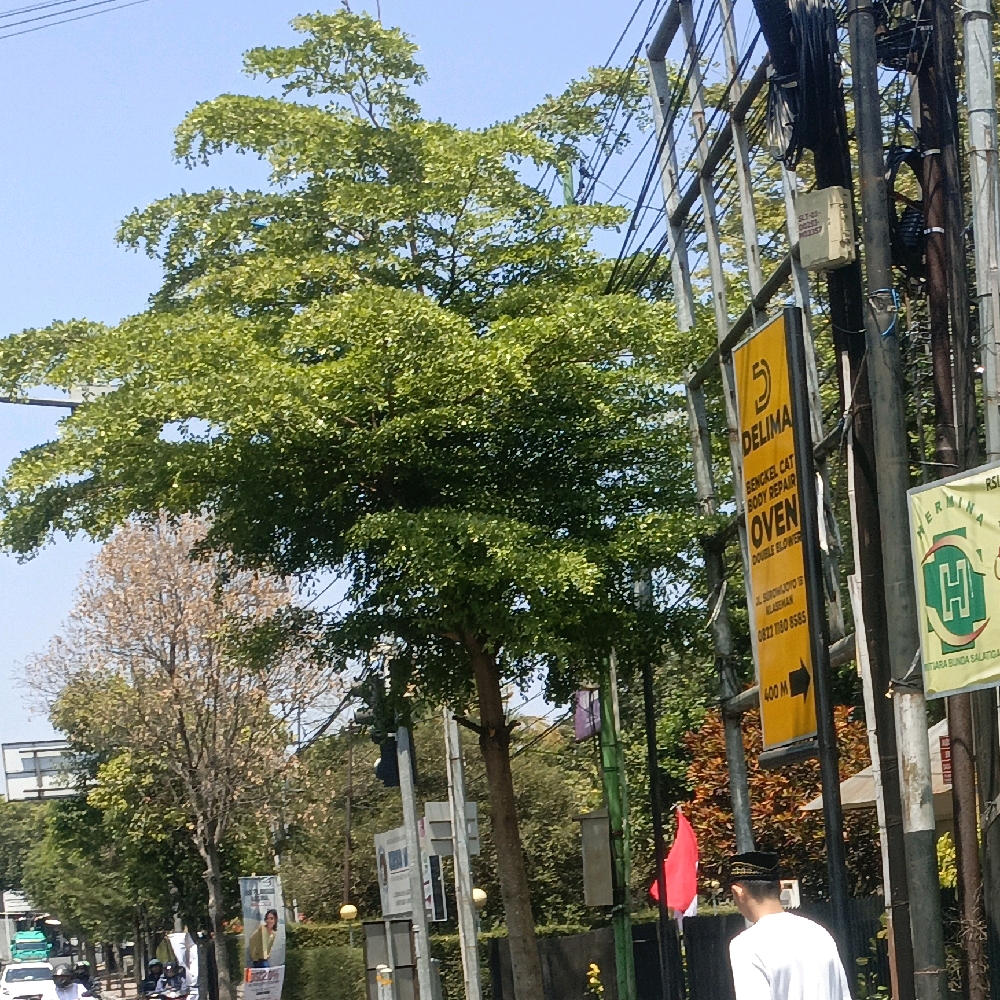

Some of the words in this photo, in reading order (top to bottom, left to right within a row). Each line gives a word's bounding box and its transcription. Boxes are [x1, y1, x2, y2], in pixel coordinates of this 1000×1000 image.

[742, 404, 793, 457] DELIMA
[779, 454, 794, 474] CAT
[747, 490, 768, 513] BODY
[769, 473, 796, 500] REPAIR
[751, 494, 798, 549] OVEN
[917, 496, 984, 539] HERMINA
[764, 684, 778, 702] 400
[780, 680, 788, 697] M
